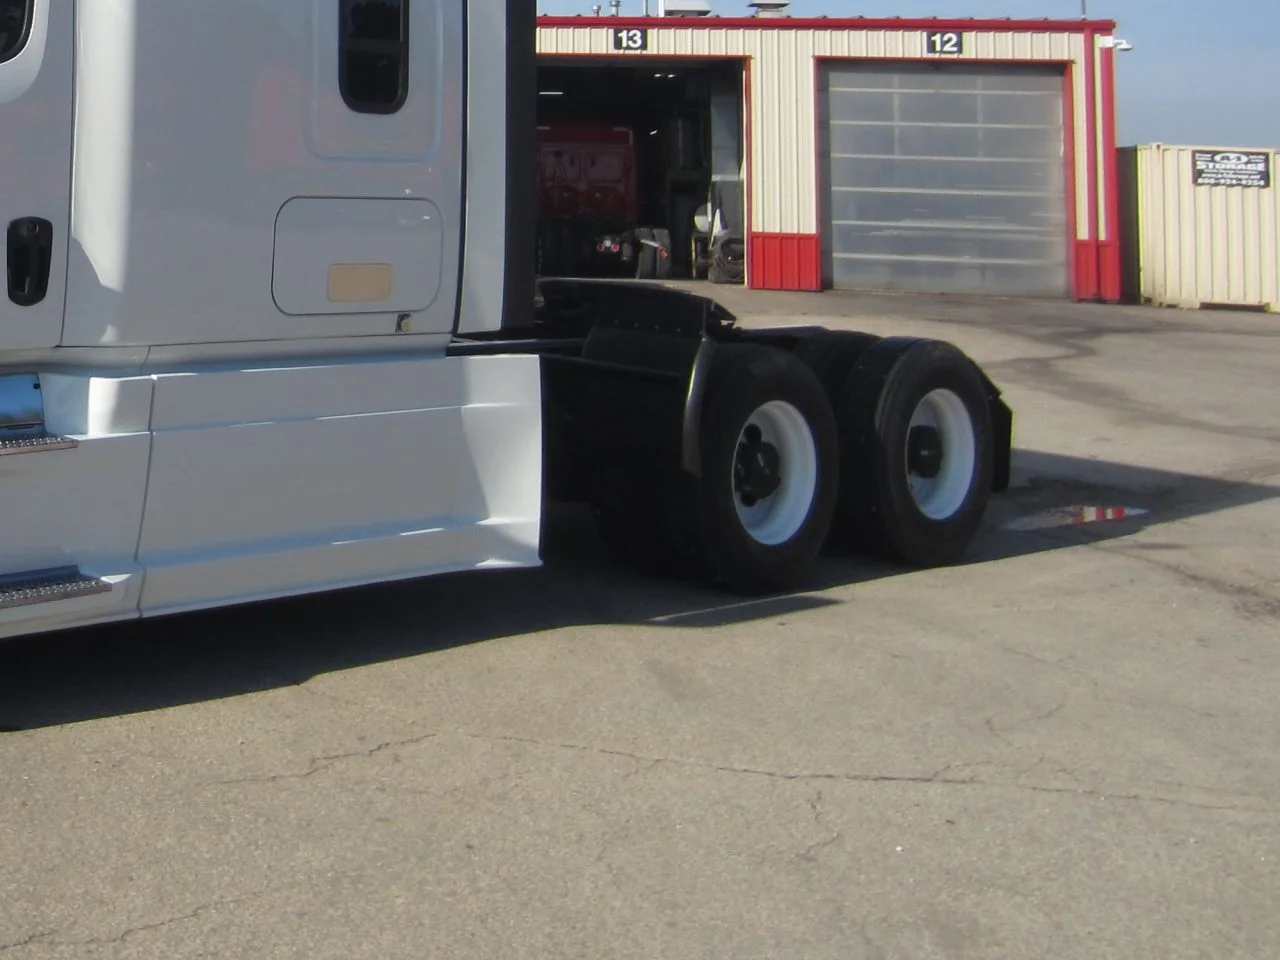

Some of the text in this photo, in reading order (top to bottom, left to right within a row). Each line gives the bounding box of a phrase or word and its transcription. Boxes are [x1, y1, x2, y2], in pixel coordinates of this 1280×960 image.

[617, 29, 642, 48] 13
[930, 32, 958, 52] 12
[1196, 160, 1266, 171] STORAGE
